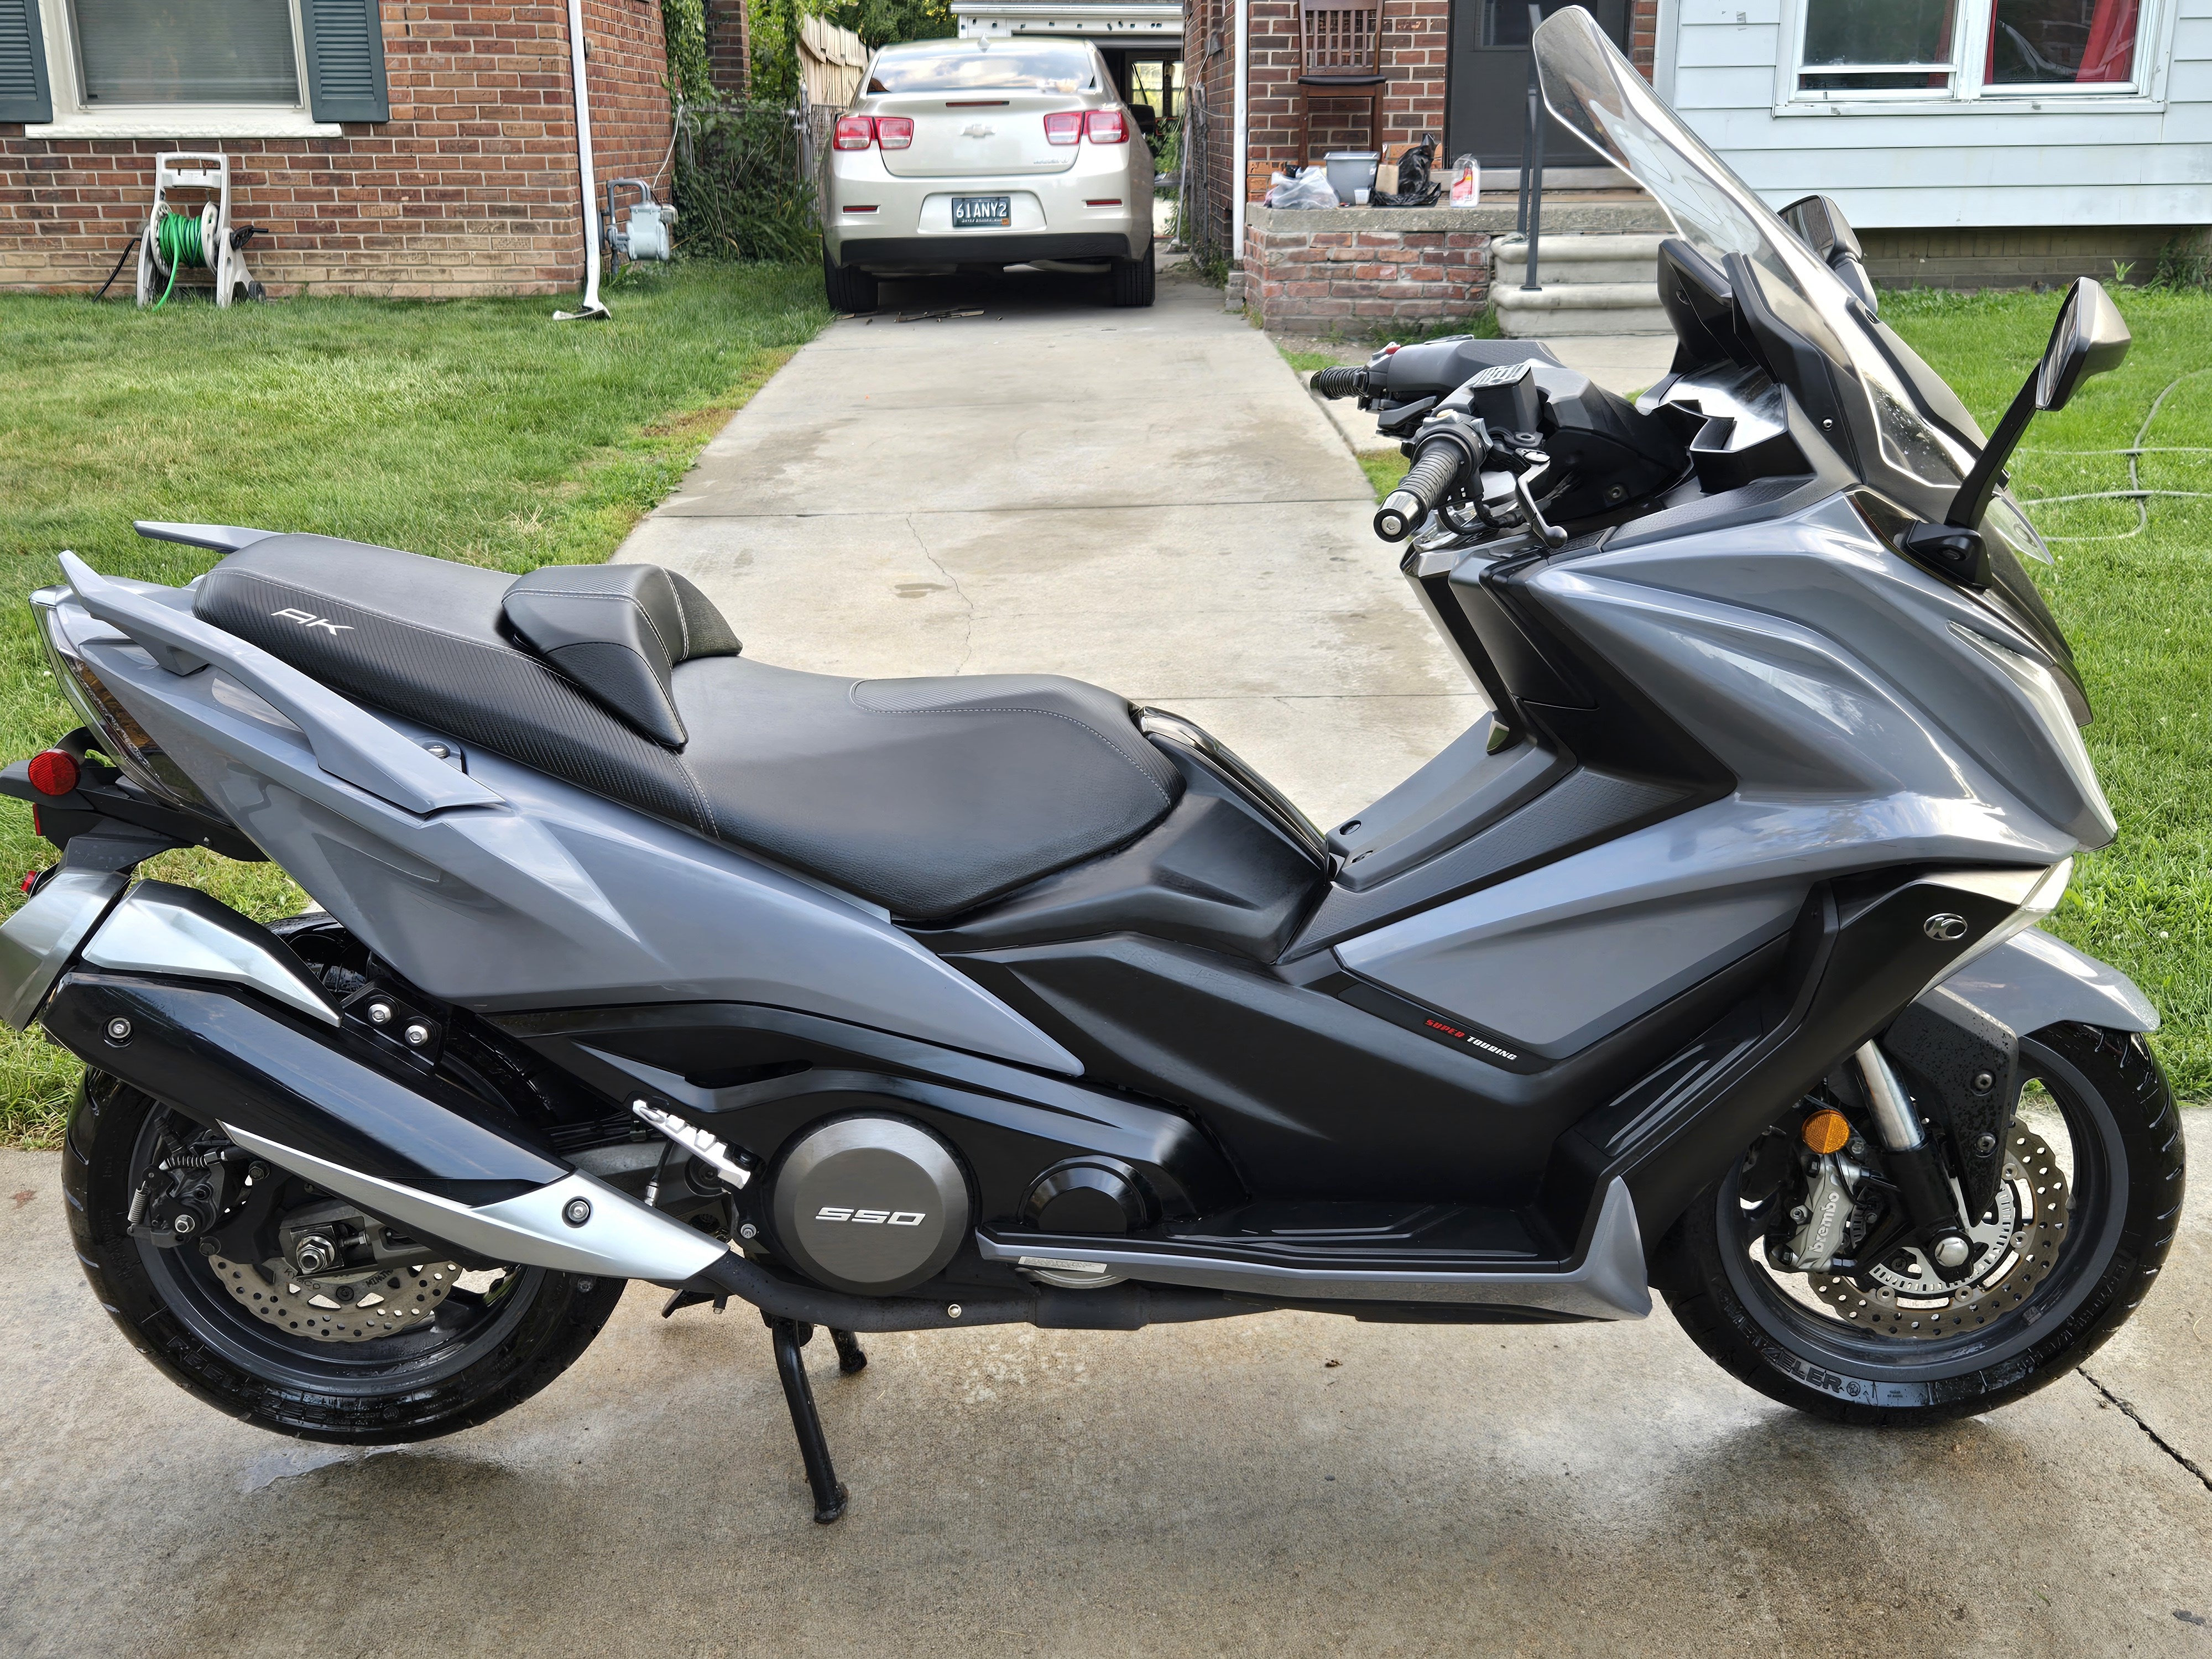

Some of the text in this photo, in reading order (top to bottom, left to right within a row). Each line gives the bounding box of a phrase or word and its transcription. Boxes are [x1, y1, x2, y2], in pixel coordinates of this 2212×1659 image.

[270, 608, 355, 636] AK
[1466, 1035, 1517, 1060] TOURING
[815, 1207, 926, 1226] 550
[1808, 1191, 1840, 1253] brembo
